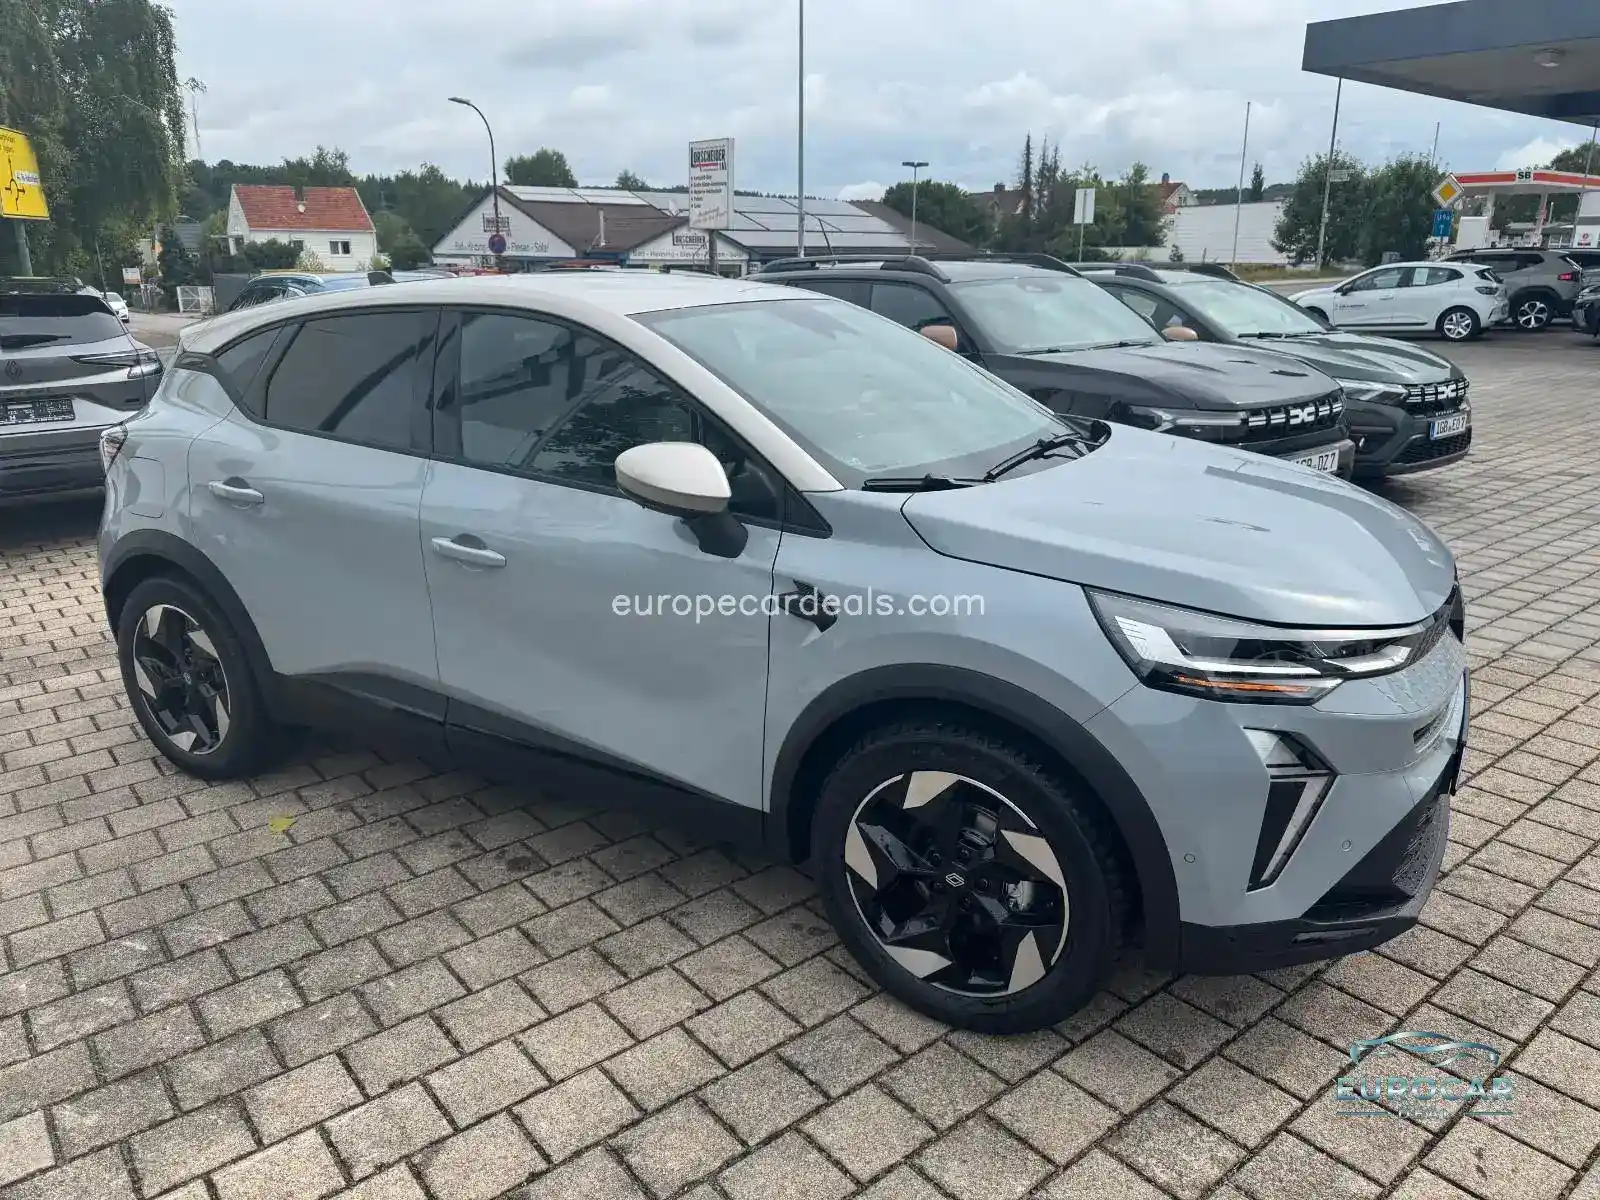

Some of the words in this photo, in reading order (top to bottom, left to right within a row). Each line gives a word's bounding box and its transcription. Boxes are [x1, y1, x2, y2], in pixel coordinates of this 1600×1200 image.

[1517, 171, 1531, 180] SB
[1318, 454, 1330, 471] DZ
[1330, 452, 1336, 469] 7
